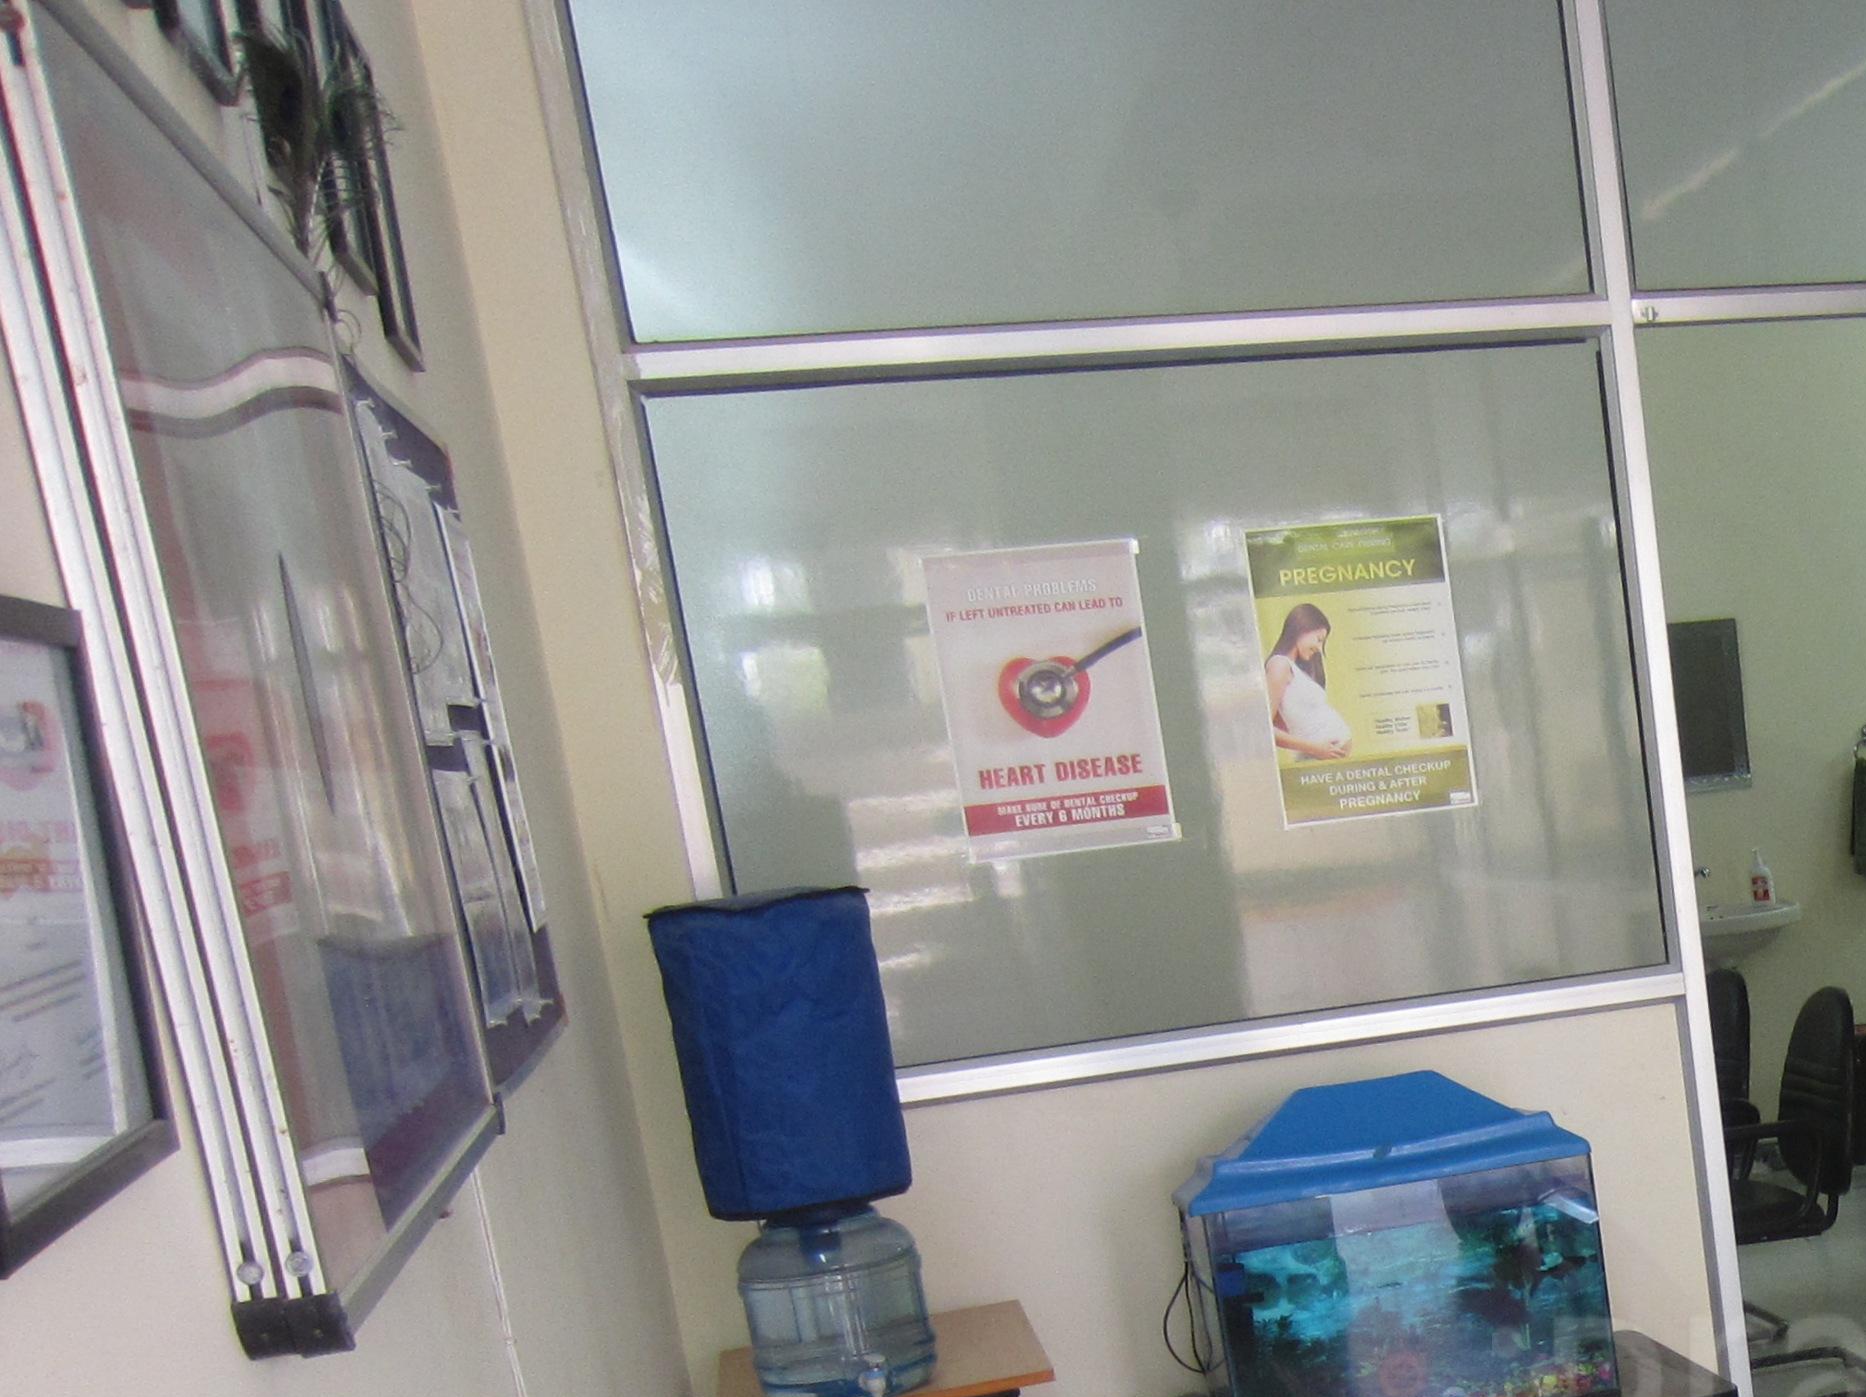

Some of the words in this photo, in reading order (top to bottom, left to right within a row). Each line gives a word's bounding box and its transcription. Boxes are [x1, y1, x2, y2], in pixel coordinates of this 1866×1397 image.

[1279, 558, 1416, 586] PREGNANCY
[967, 585, 1017, 602] DENTAL
[1024, 578, 1097, 598] PROBLEMS
[945, 611, 957, 623] IF
[959, 609, 984, 621] LEFT
[988, 604, 1051, 619] UNTREATED
[1054, 601, 1076, 614] CAN
[1079, 598, 1106, 611] LEAD
[1109, 596, 1123, 608] TO
[979, 763, 1046, 790] HEART
[1054, 754, 1144, 782] DISEASE
[1300, 773, 1335, 785] HAVE
[1335, 772, 1345, 782] A
[1346, 766, 1393, 780] DENTAL
[1395, 760, 1451, 775] CHECKUP
[1329, 781, 1376, 796] DURING
[1378, 779, 1388, 790] &
[1389, 776, 1428, 789] AFTER
[1339, 790, 1422, 810] PREGNANCY
[1015, 812, 1054, 828] EVERY
[1059, 810, 1068, 822] 6
[1072, 804, 1126, 821] MONTHS
